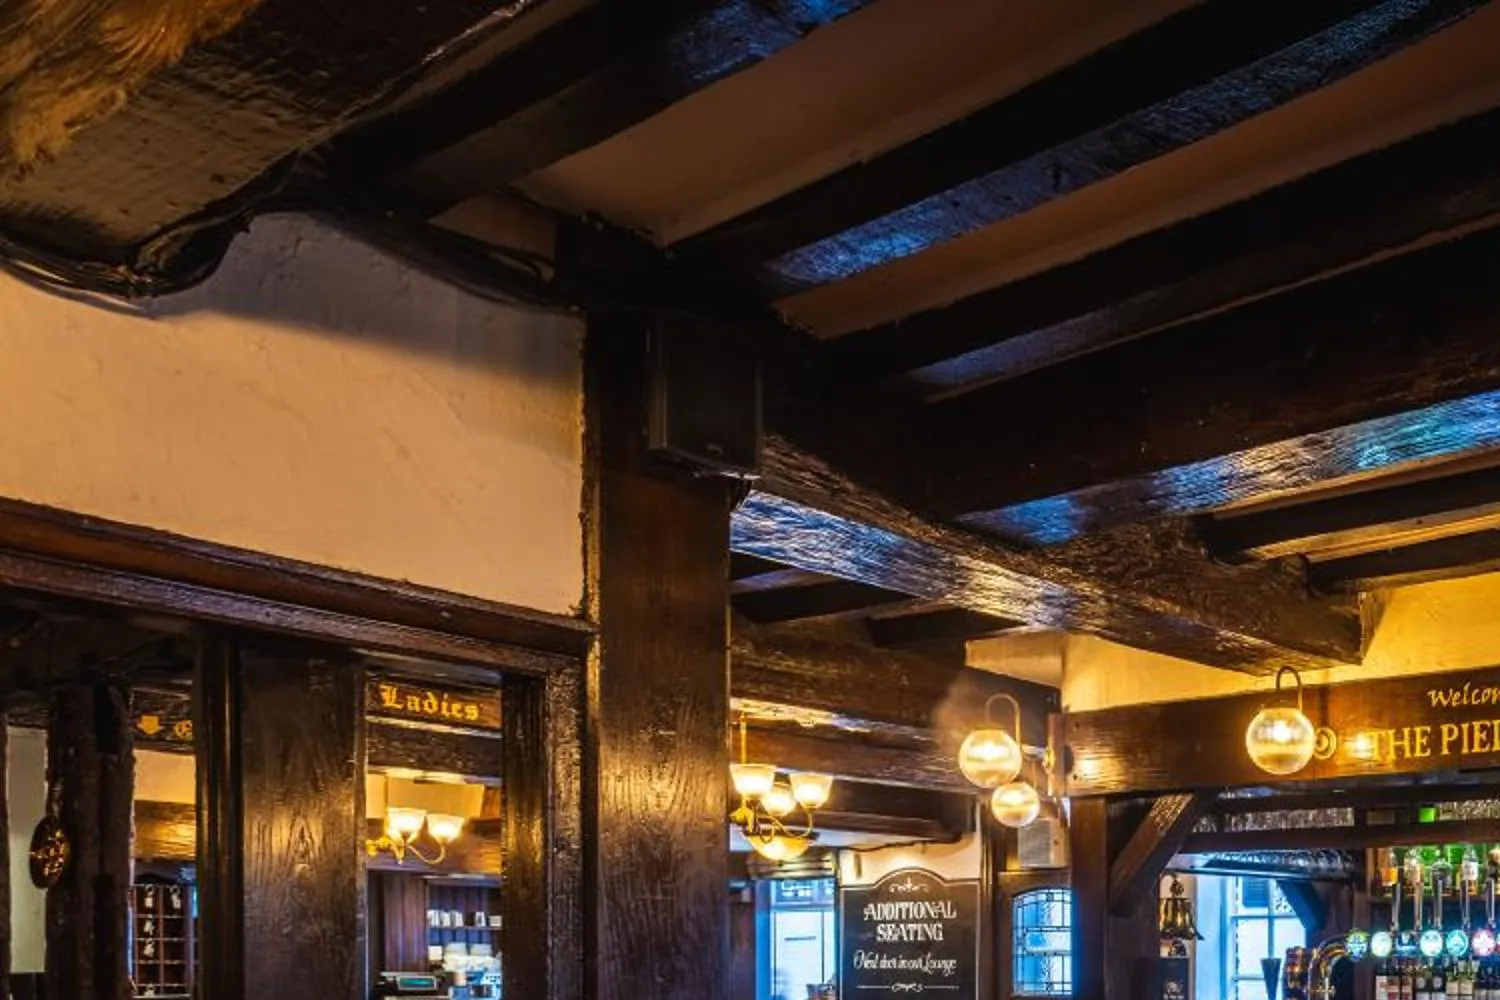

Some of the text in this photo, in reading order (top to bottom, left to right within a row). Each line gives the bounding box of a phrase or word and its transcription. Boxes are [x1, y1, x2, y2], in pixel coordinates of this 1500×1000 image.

[378, 683, 478, 720] Ladies
[1367, 726, 1431, 764] THE
[863, 901, 957, 921] ADDITIONAL
[876, 923, 944, 942] SEATING
